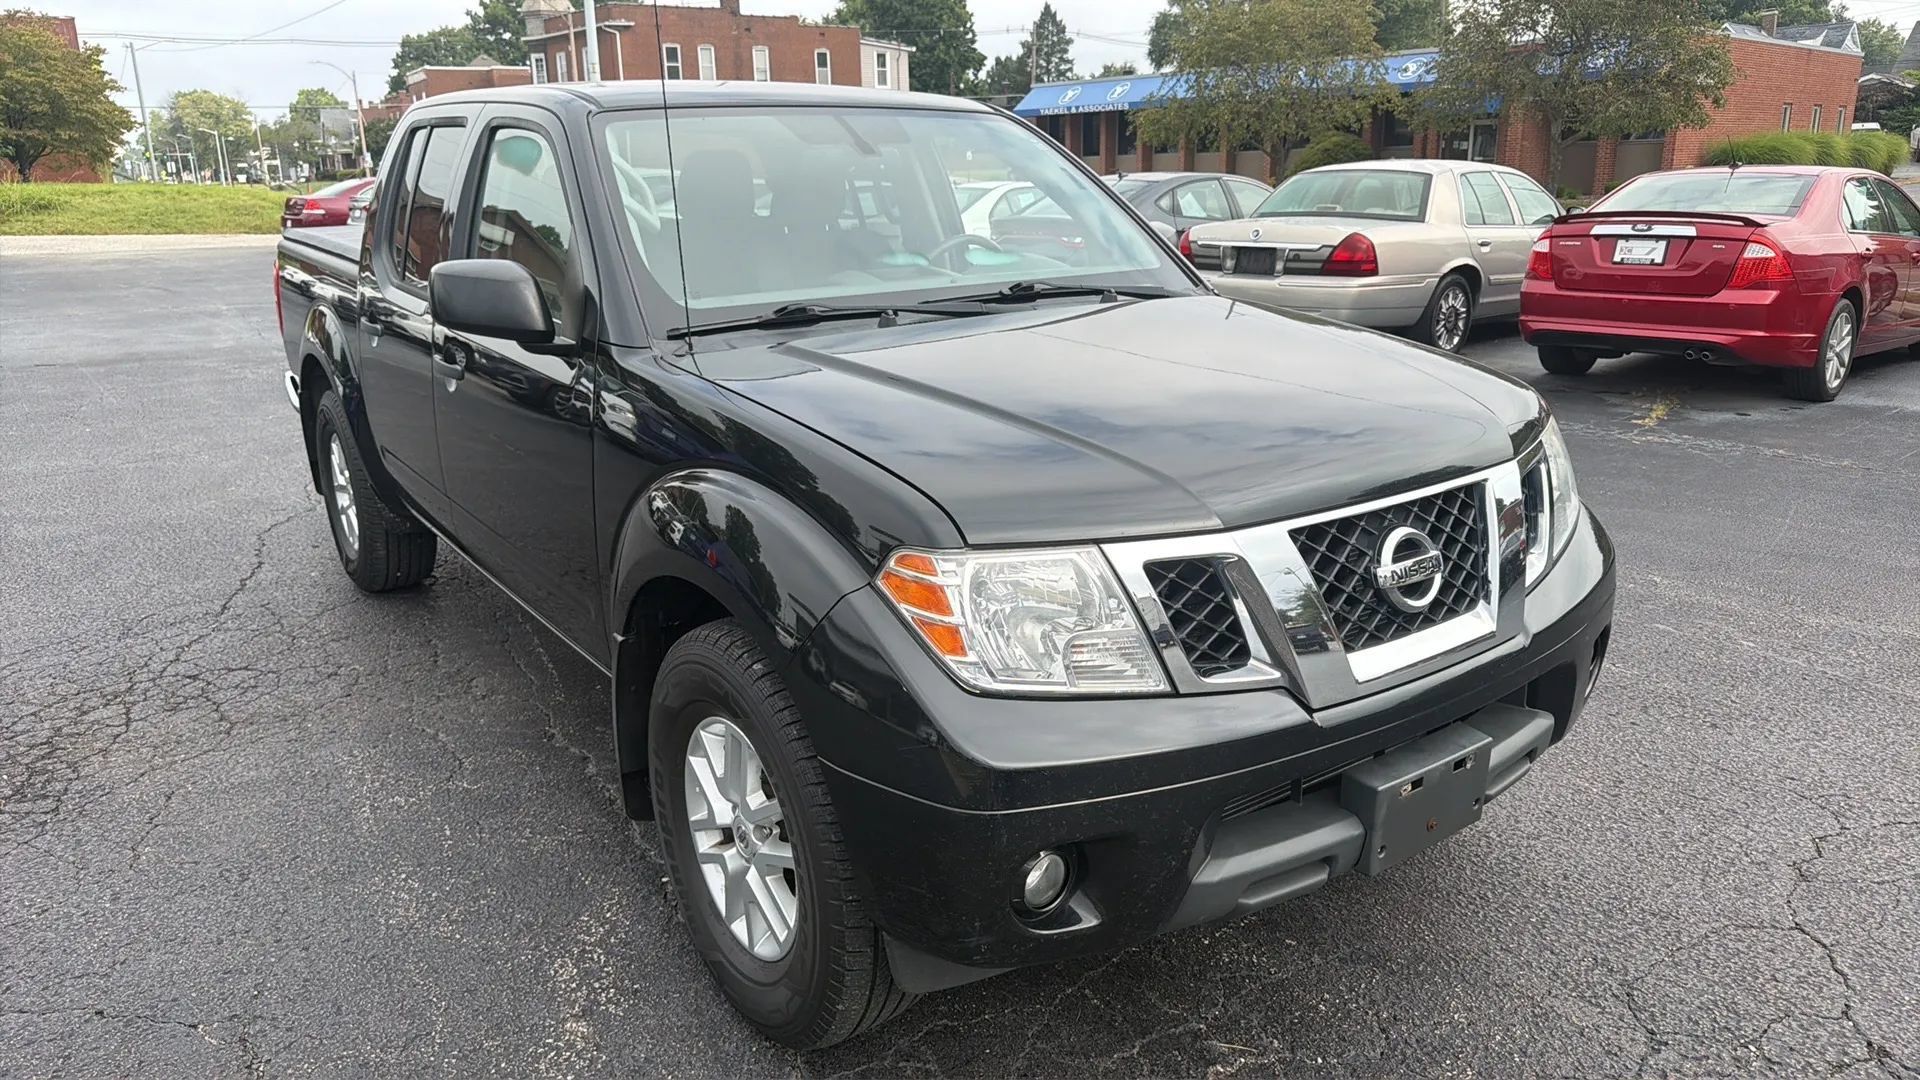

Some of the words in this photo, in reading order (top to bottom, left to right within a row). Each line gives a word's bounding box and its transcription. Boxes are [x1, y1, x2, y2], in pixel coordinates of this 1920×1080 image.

[1039, 107, 1070, 115] YAEKEL
[1071, 106, 1077, 114] &
[1078, 103, 1129, 113] ASSOCIATES
[1391, 555, 1441, 582] NISSAN
